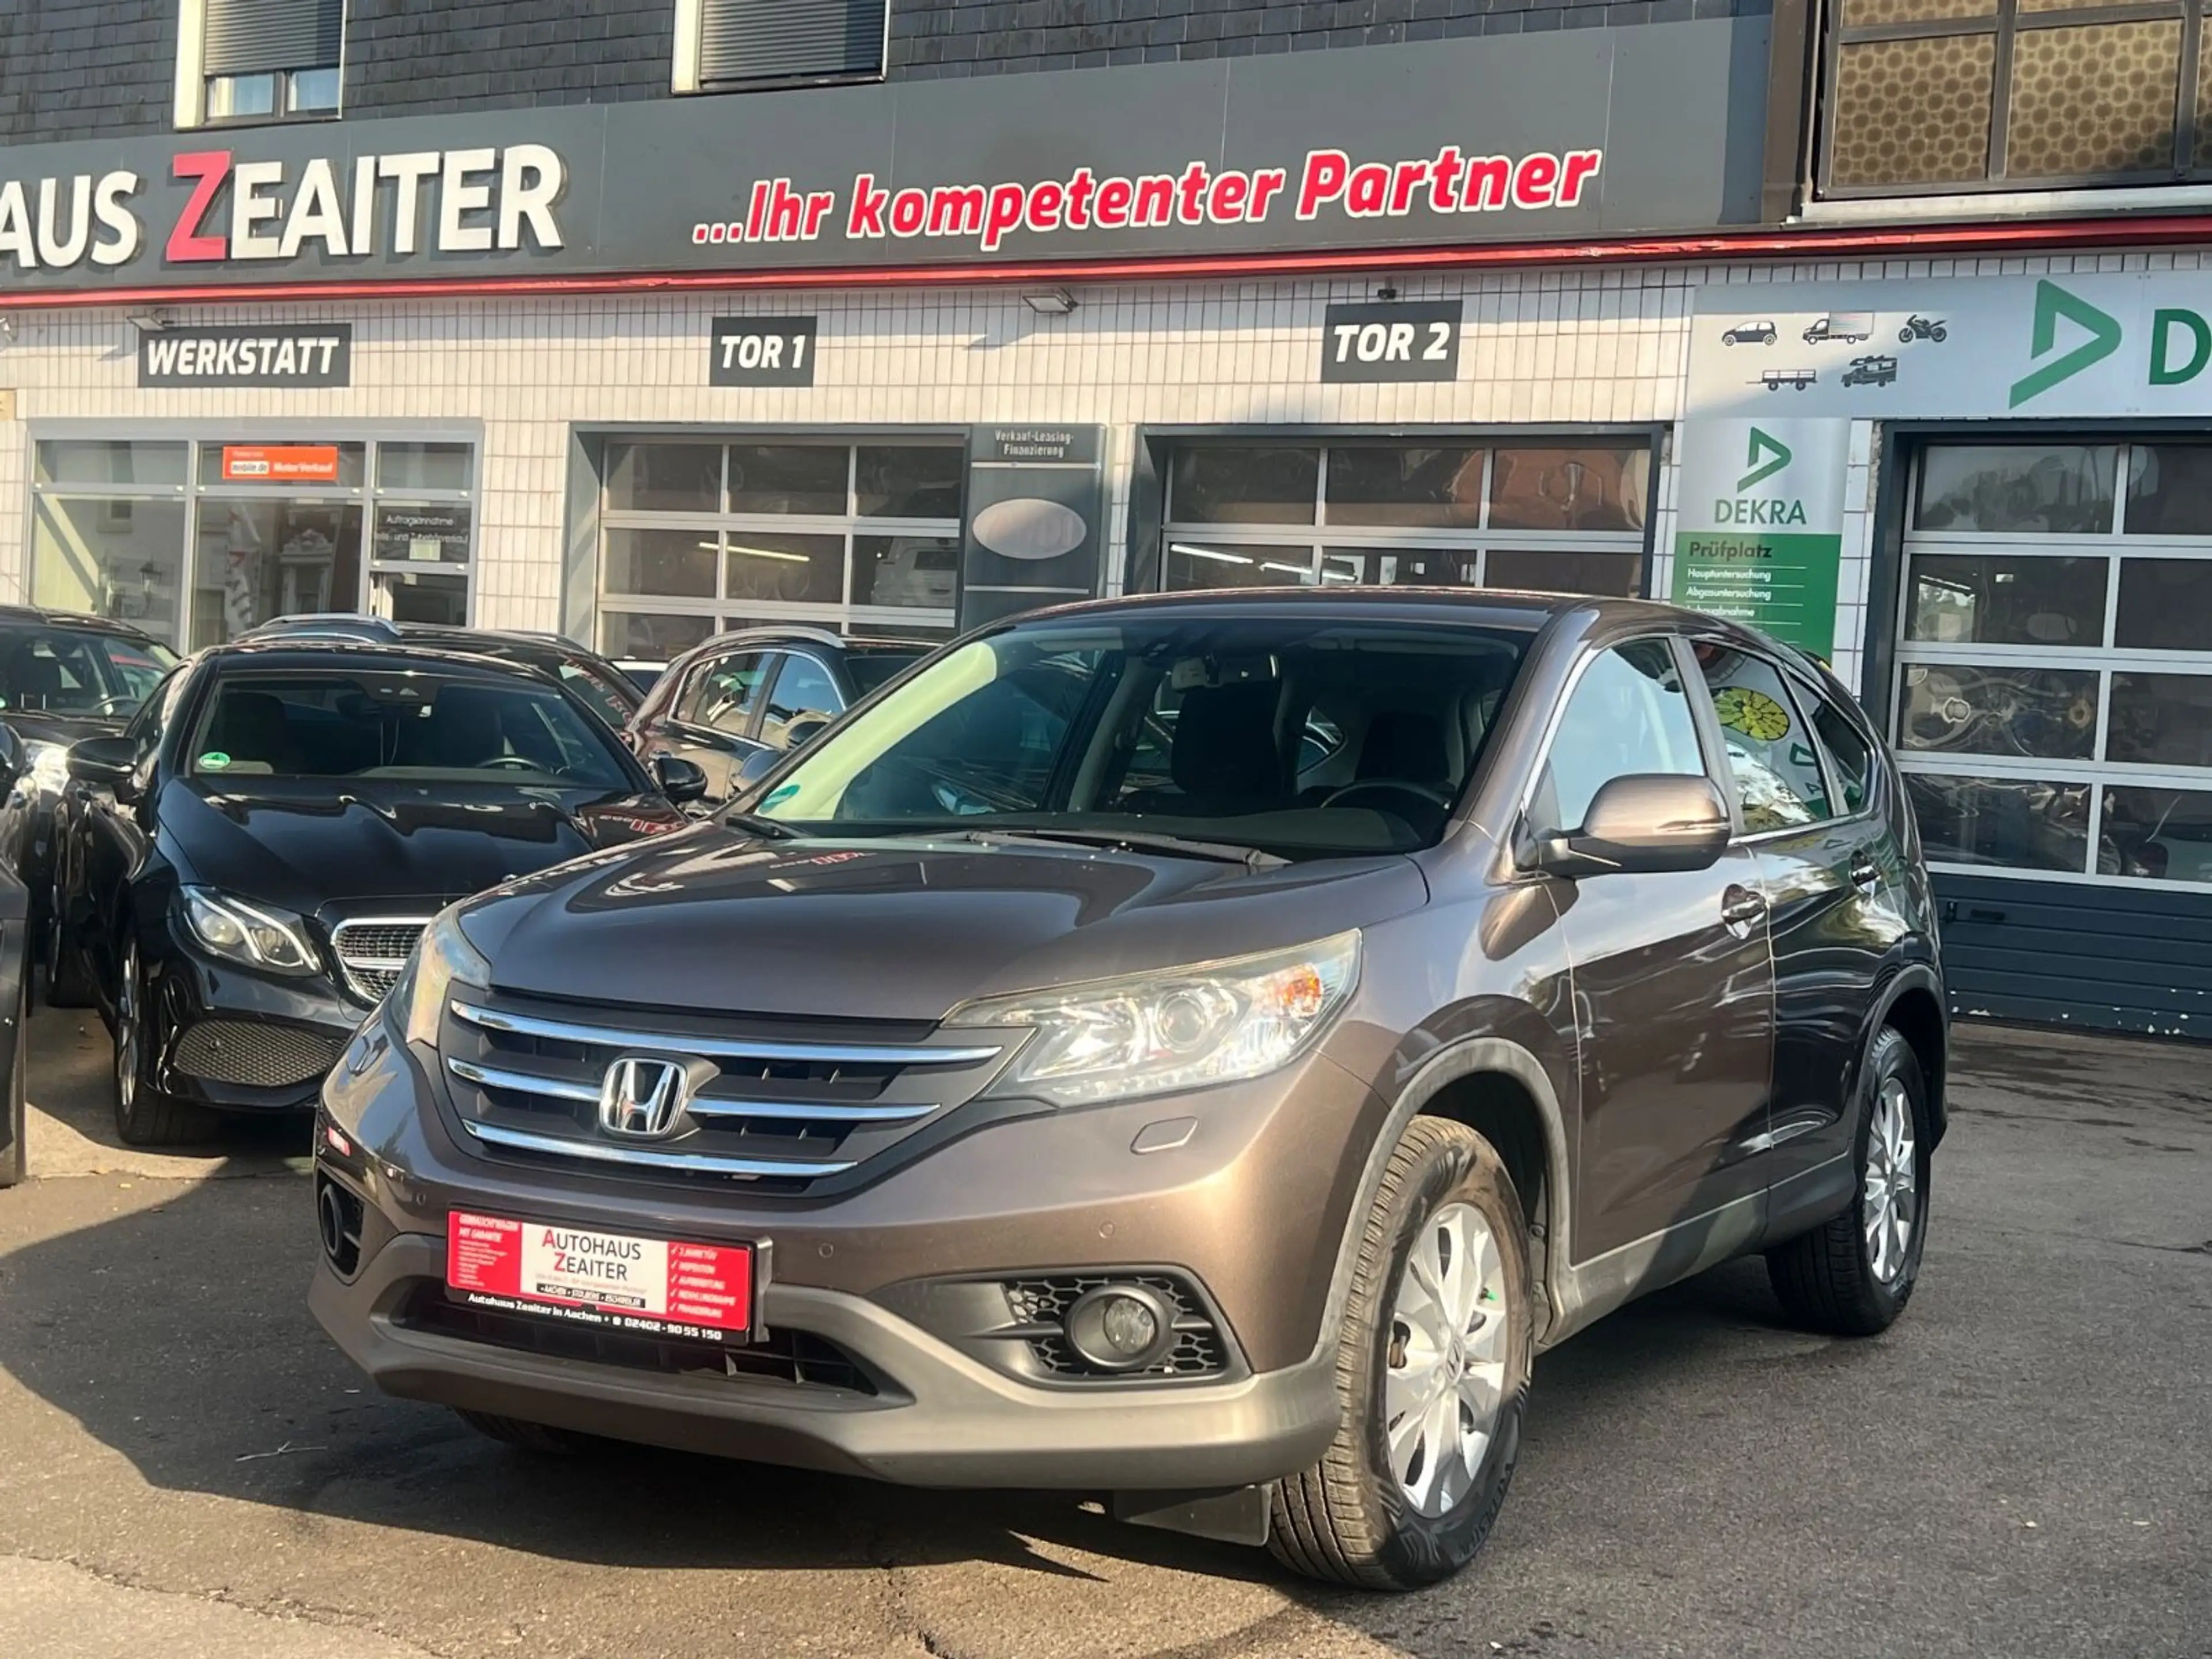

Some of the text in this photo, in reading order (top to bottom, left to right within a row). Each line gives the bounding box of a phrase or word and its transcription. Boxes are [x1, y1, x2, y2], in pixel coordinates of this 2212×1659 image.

[166, 144, 565, 262] ZEAITER
[846, 161, 1286, 251] kompetenter
[1296, 146, 1601, 220] Partner
[147, 336, 339, 376] WERKSTATT
[721, 335, 806, 369] TOR 1
[1334, 322, 1450, 362] TOR 2
[1004, 444, 1065, 457] Finanzierung
[1714, 499, 1807, 525] DEKRA
[1689, 541, 1772, 561] Prüfplatz
[1688, 567, 1771, 582] Hauptuntersuchung
[1685, 586, 1771, 601] Abgasuntersuchung
[542, 1229, 641, 1260] AUTOHAUS
[553, 1252, 627, 1281] ZEAITER
[468, 1293, 514, 1309] Autohaus
[516, 1301, 551, 1315] Zeaiter
[553, 1306, 562, 1317] in
[564, 1308, 602, 1323] Aachen
